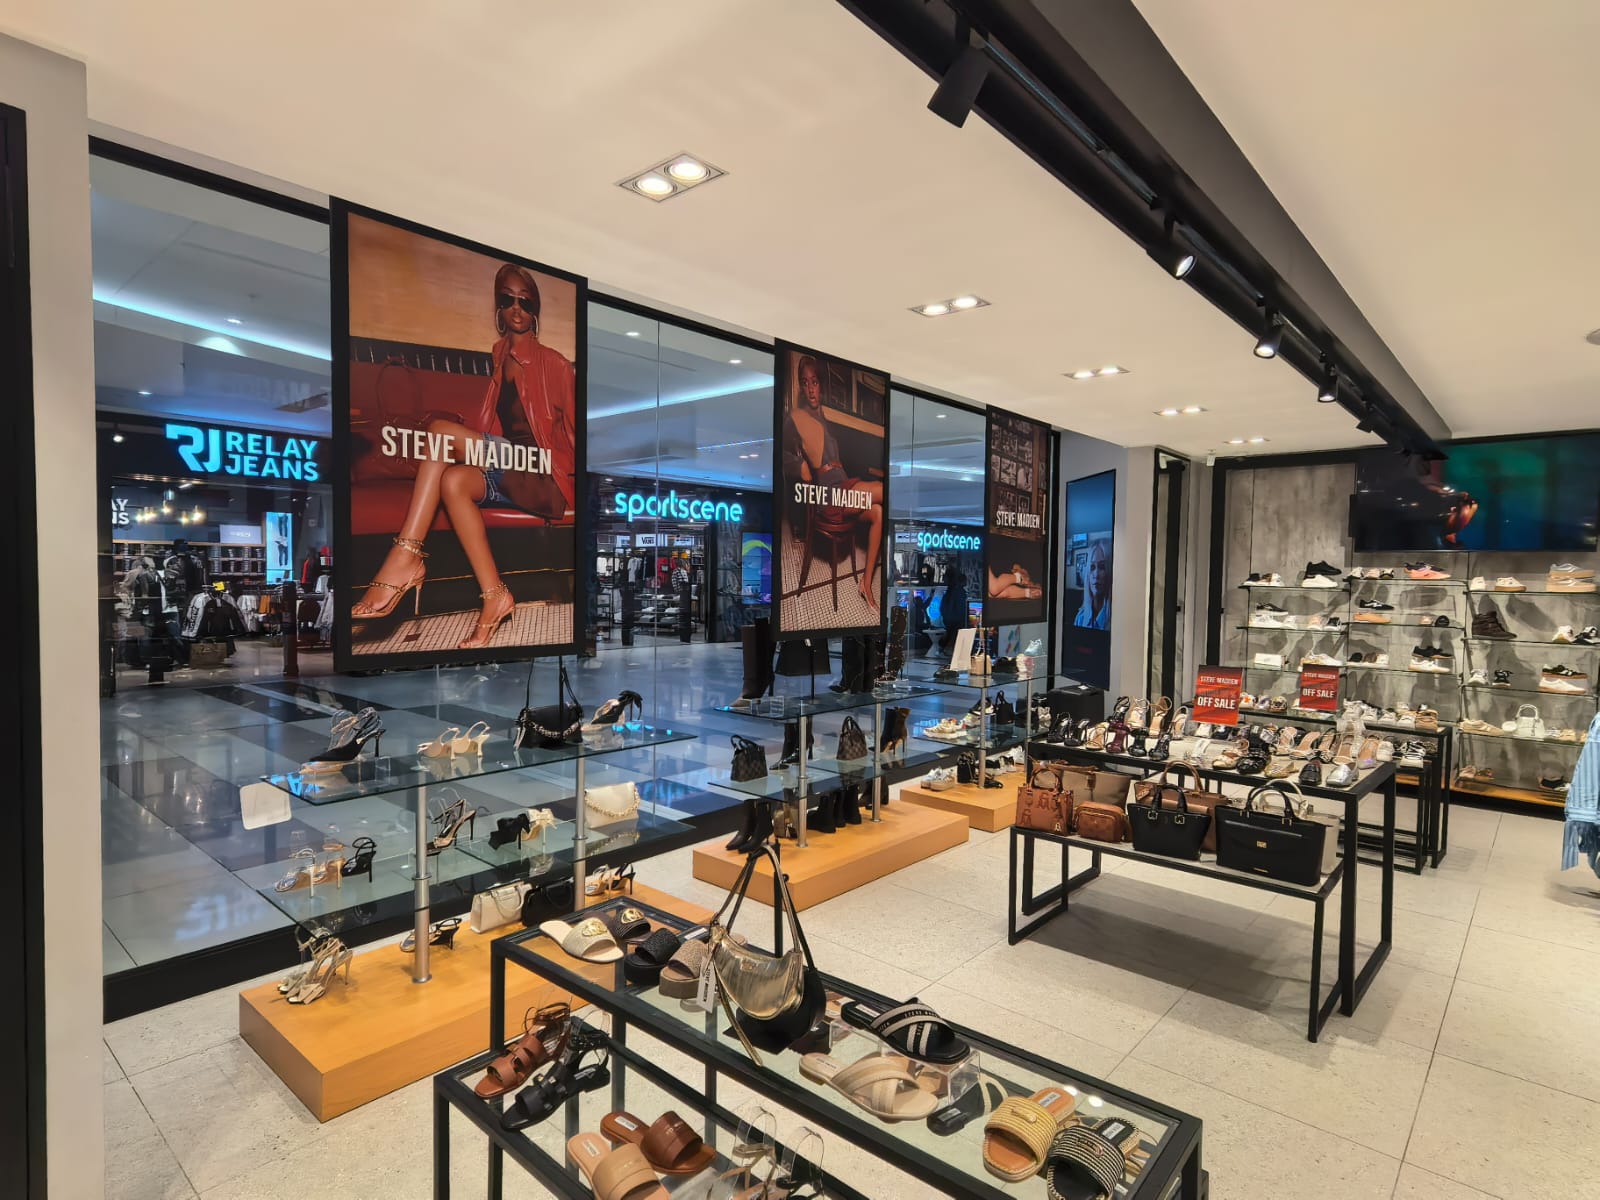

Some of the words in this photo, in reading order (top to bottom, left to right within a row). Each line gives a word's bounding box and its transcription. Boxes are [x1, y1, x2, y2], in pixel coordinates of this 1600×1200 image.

[226, 431, 319, 460] RELAY
[381, 425, 456, 463] STEVE
[464, 437, 552, 475] MADDEN
[224, 453, 320, 482] JEANS
[614, 489, 745, 522] sportscene
[794, 481, 829, 506] STEVE
[831, 486, 873, 511] MADDEN
[996, 510, 1016, 527] STEVE
[1016, 511, 1041, 529] MADDEN
[917, 528, 982, 553] sportscene
[1197, 696, 1213, 707] OFF
[1213, 697, 1236, 710] SALE
[1302, 687, 1316, 697] OFF
[1316, 688, 1336, 699] SALE
